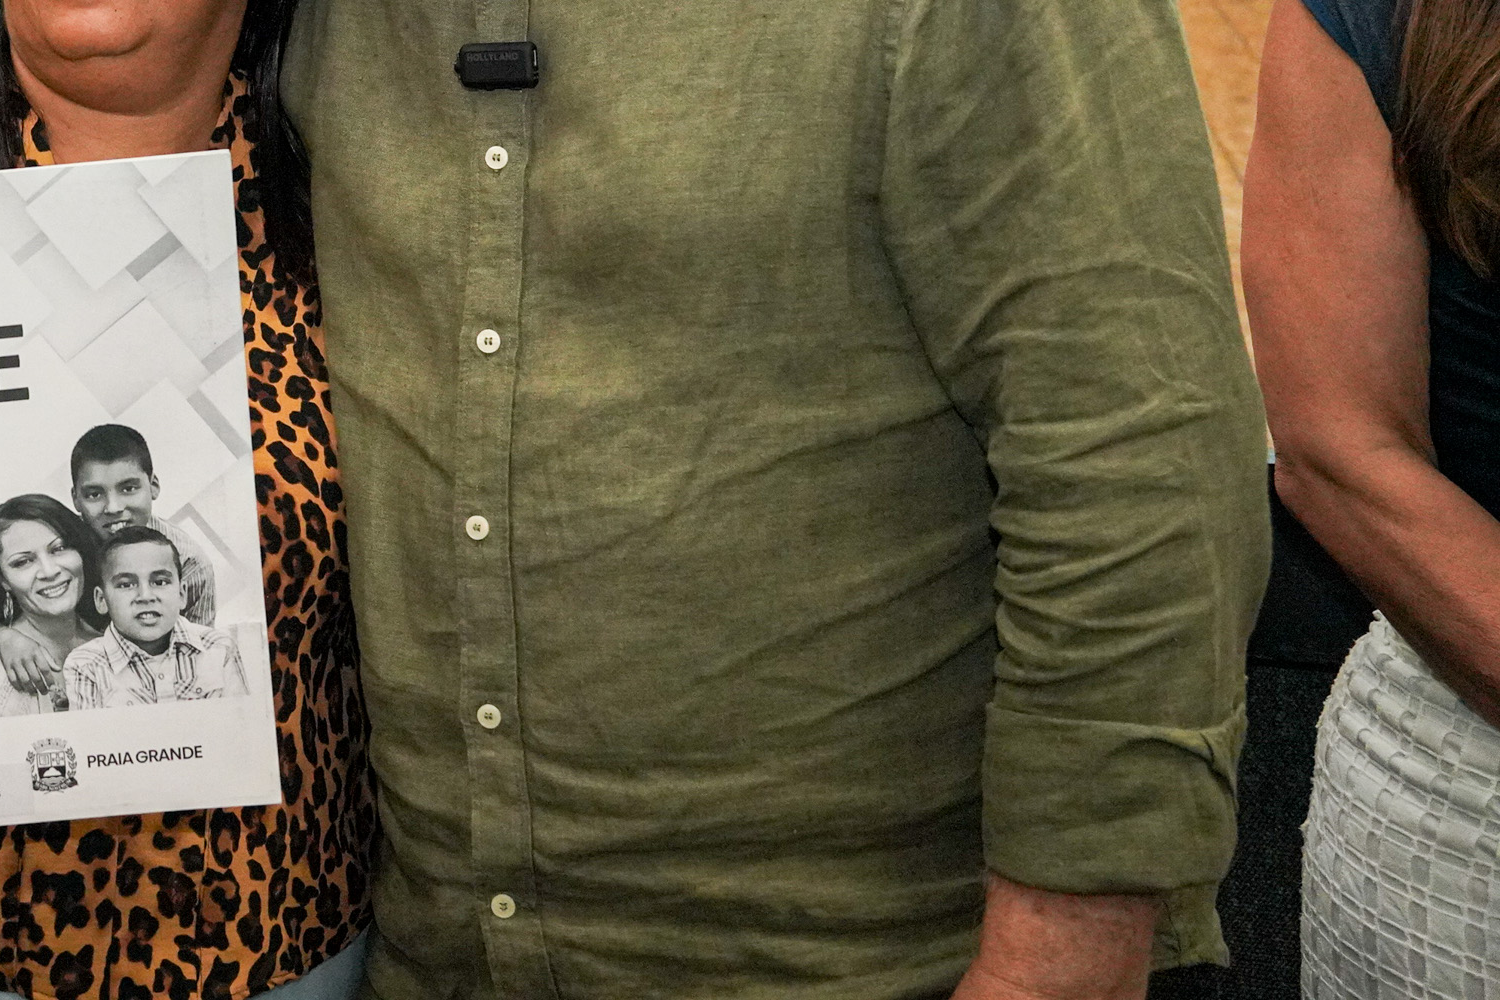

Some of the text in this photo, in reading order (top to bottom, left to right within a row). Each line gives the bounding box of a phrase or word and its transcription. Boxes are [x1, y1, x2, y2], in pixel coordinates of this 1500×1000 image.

[466, 52, 518, 62] HOLLYLAND
[86, 745, 203, 768] PRAIA GRANDE
